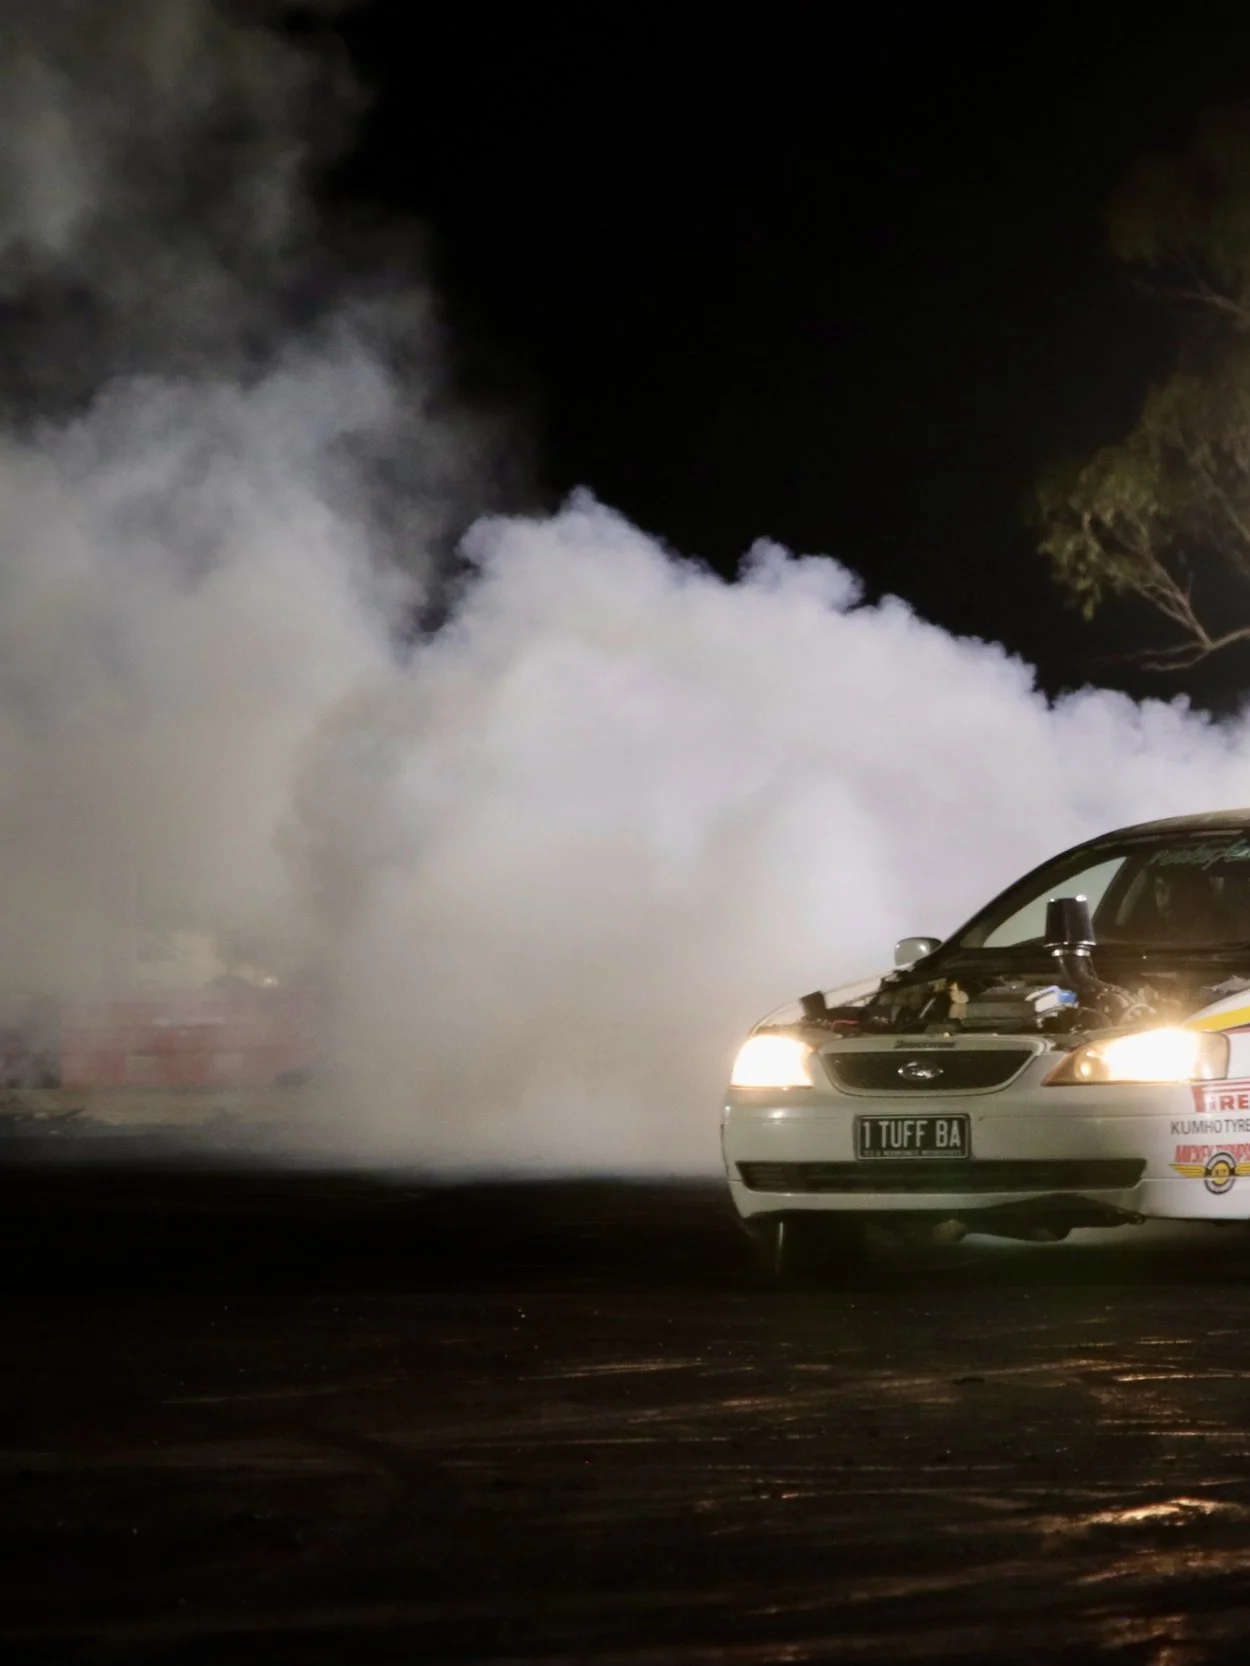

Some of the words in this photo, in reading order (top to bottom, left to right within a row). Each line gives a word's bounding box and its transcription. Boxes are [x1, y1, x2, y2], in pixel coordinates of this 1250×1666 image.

[862, 1121, 871, 1149] 1
[878, 1120, 929, 1148] TUFF
[936, 1120, 961, 1148] BA
